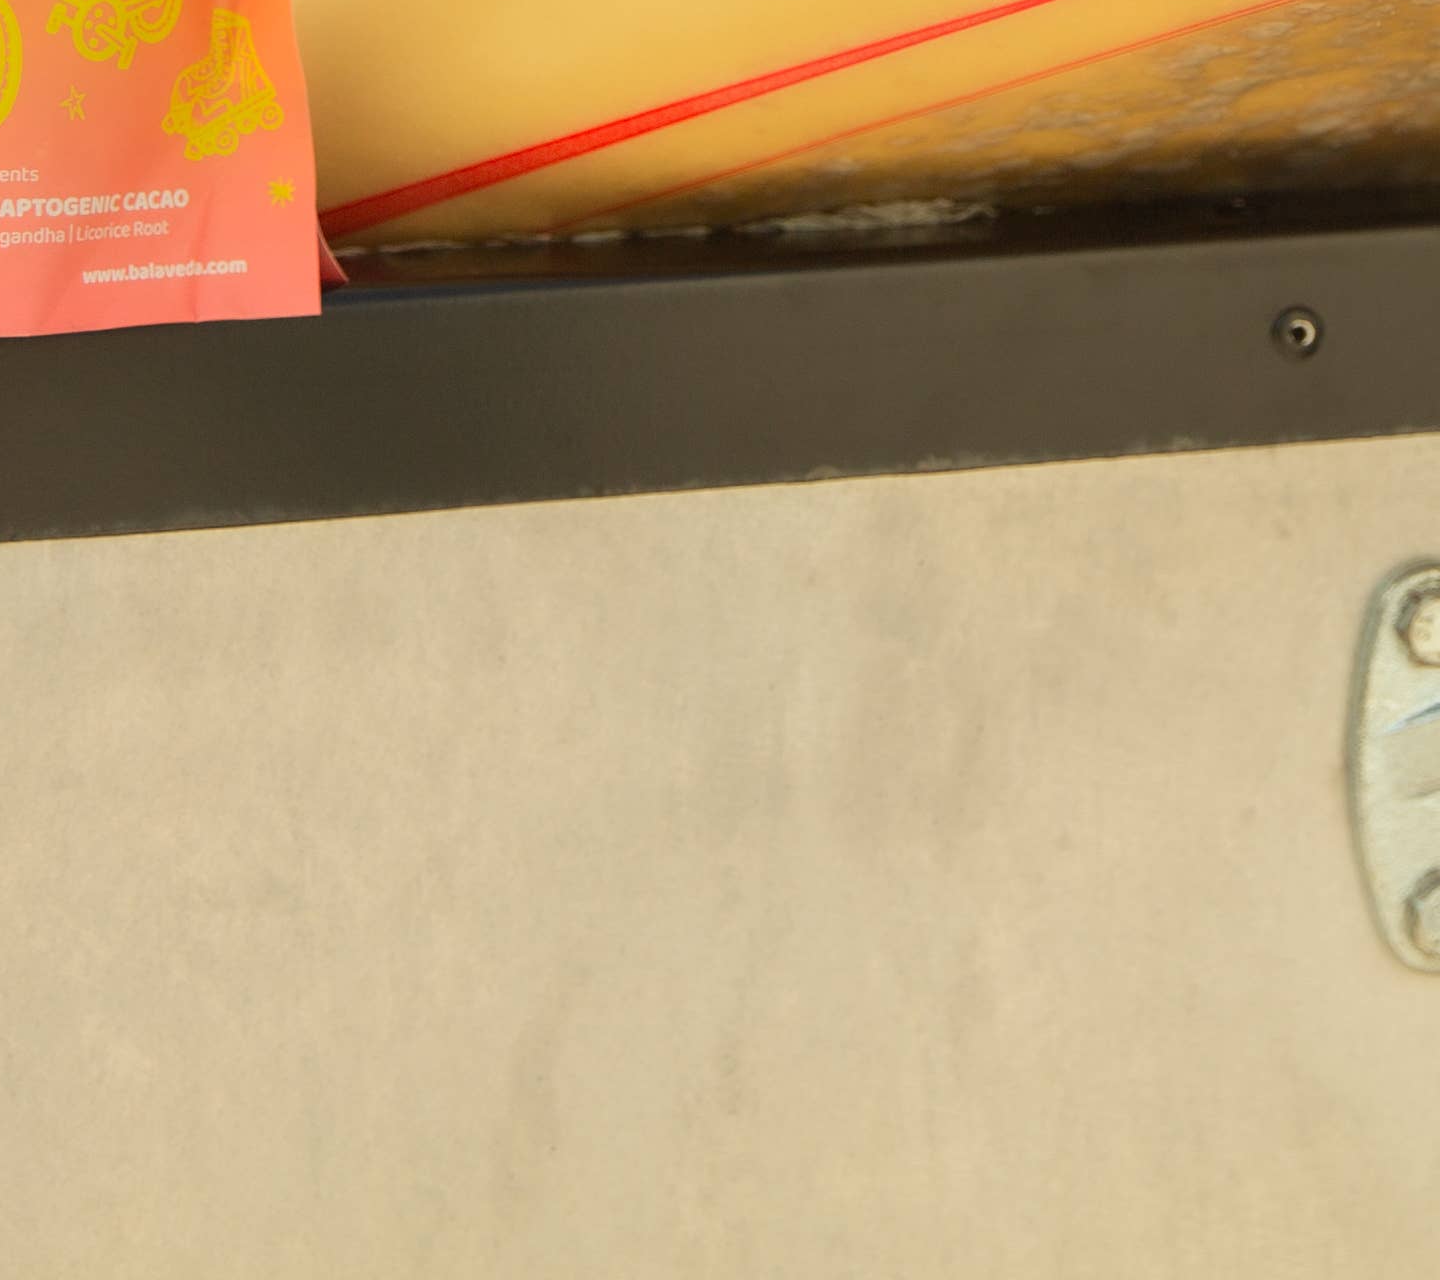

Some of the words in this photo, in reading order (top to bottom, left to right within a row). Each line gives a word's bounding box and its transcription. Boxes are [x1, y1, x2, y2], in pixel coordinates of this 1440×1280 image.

[122, 188, 190, 212] CACAO
[76, 222, 130, 242] Licorice
[133, 219, 170, 237] Root
[81, 259, 248, 285] www.balaveda.com
